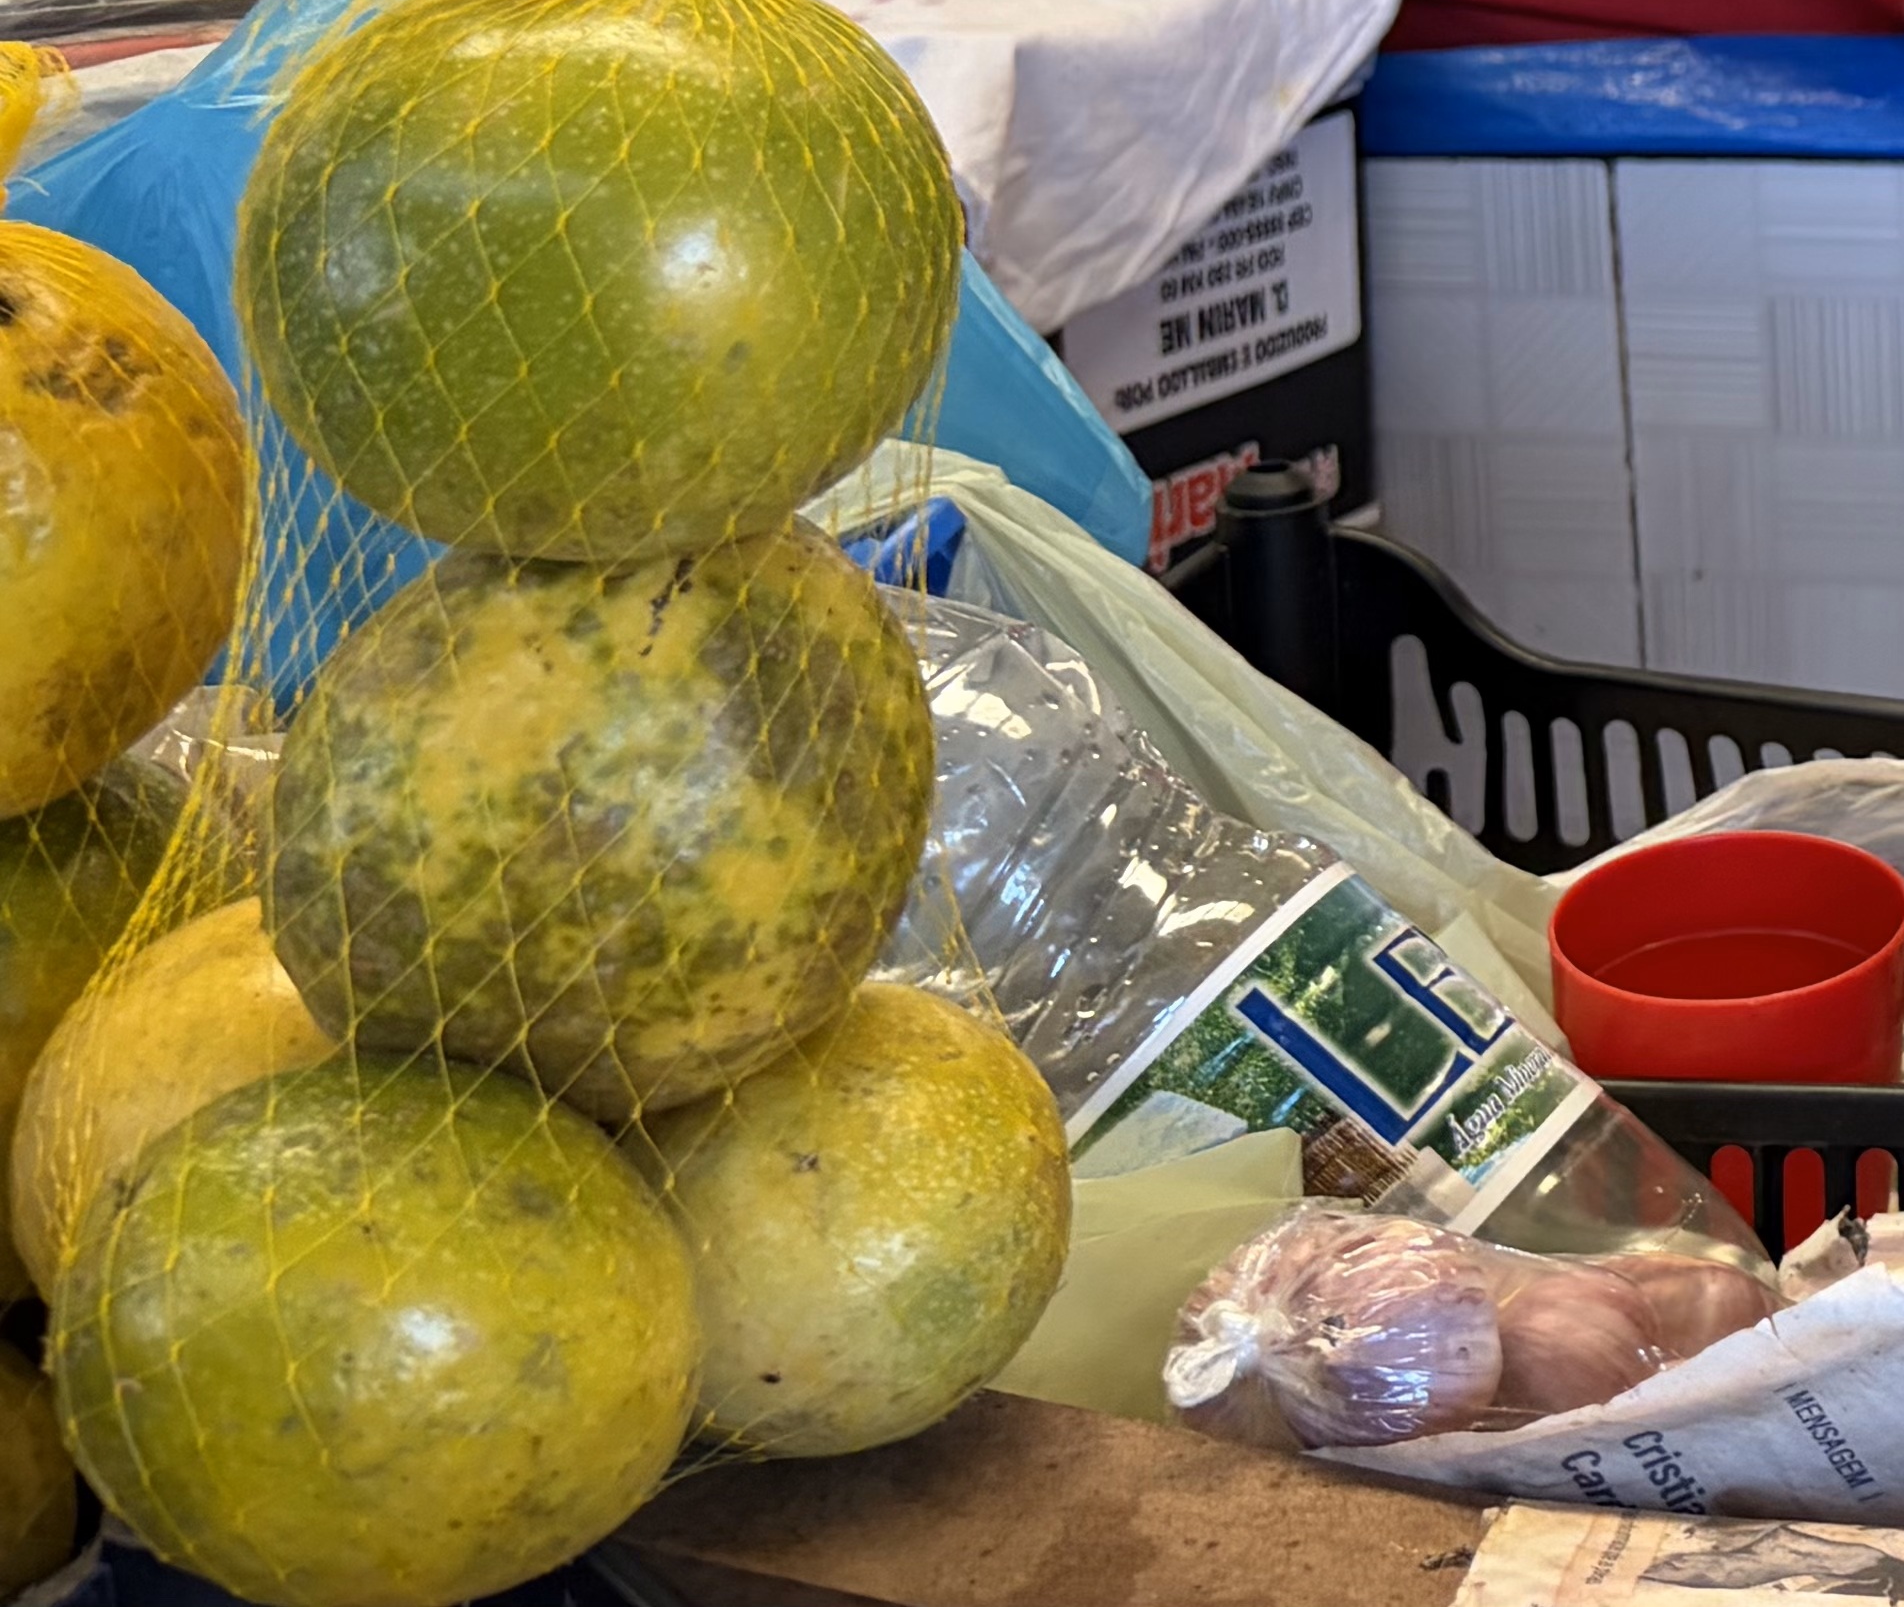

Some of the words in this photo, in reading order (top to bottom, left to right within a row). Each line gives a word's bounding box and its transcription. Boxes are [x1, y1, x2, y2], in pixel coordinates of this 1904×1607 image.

[1160, 312, 1191, 357] ME
[1254, 311, 1329, 364] PRODUZIDO
[1158, 347, 1238, 400] EMBALADO
[1622, 1429, 1707, 1516] Cristia
[1784, 1388, 1877, 1503] MENSAGEM
[1560, 1449, 1638, 1511] Car
